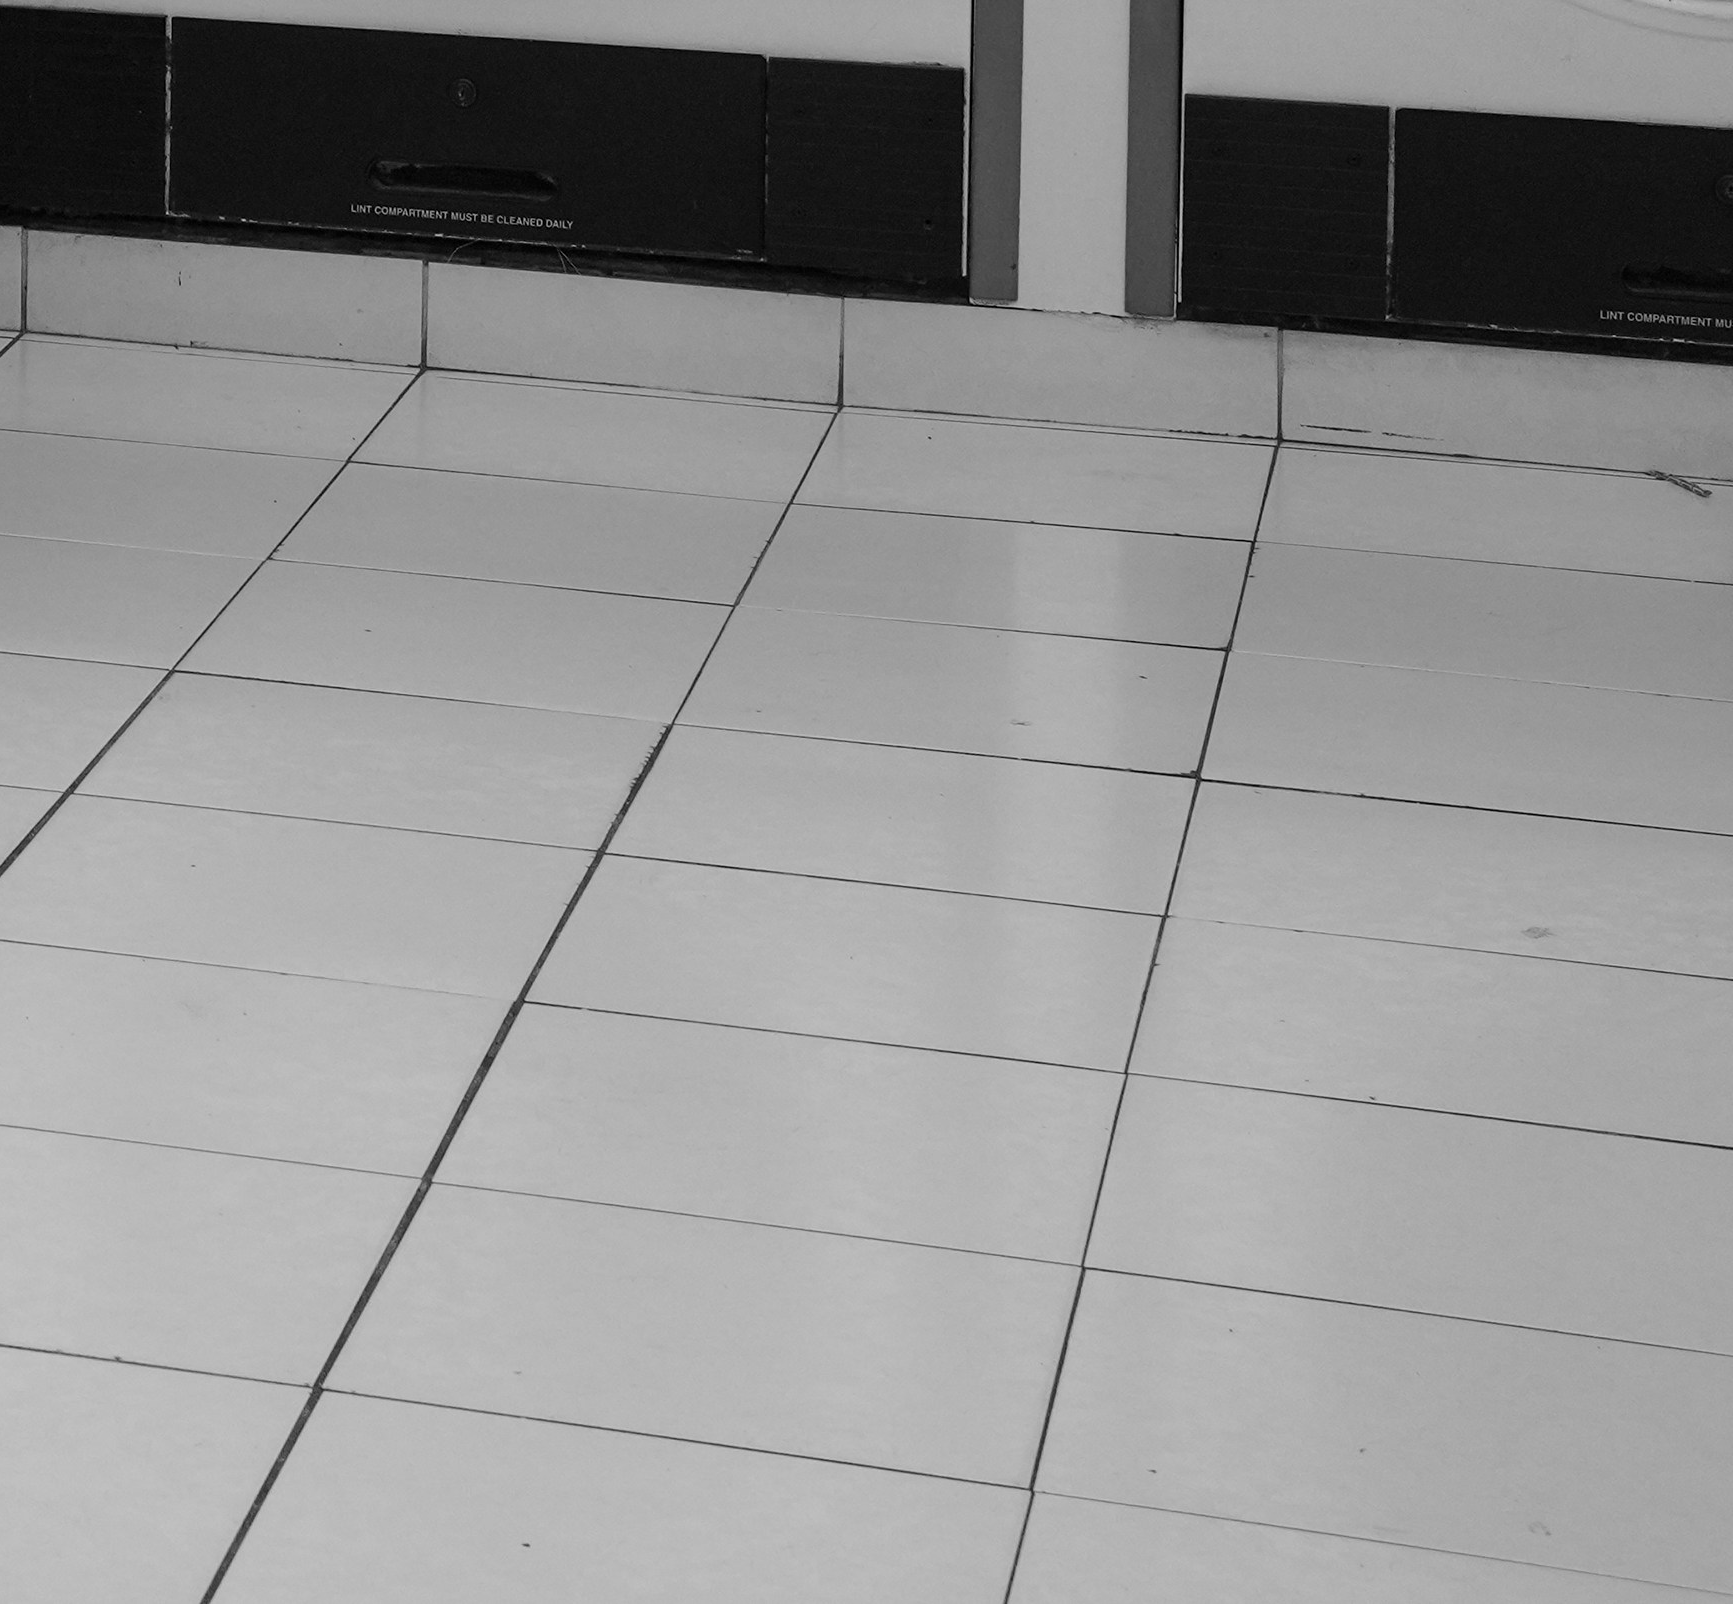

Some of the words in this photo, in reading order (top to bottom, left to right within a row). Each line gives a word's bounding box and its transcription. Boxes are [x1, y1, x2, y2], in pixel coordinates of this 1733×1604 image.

[350, 204, 372, 213] LINT
[374, 205, 448, 219] COMPARTMENT
[451, 212, 478, 222] MUST
[480, 214, 494, 223] BE
[496, 215, 543, 227] CLEANED
[545, 218, 573, 229] DAILY
[1599, 310, 1624, 320] LINT
[1627, 312, 1712, 326] COMPARTMENT
